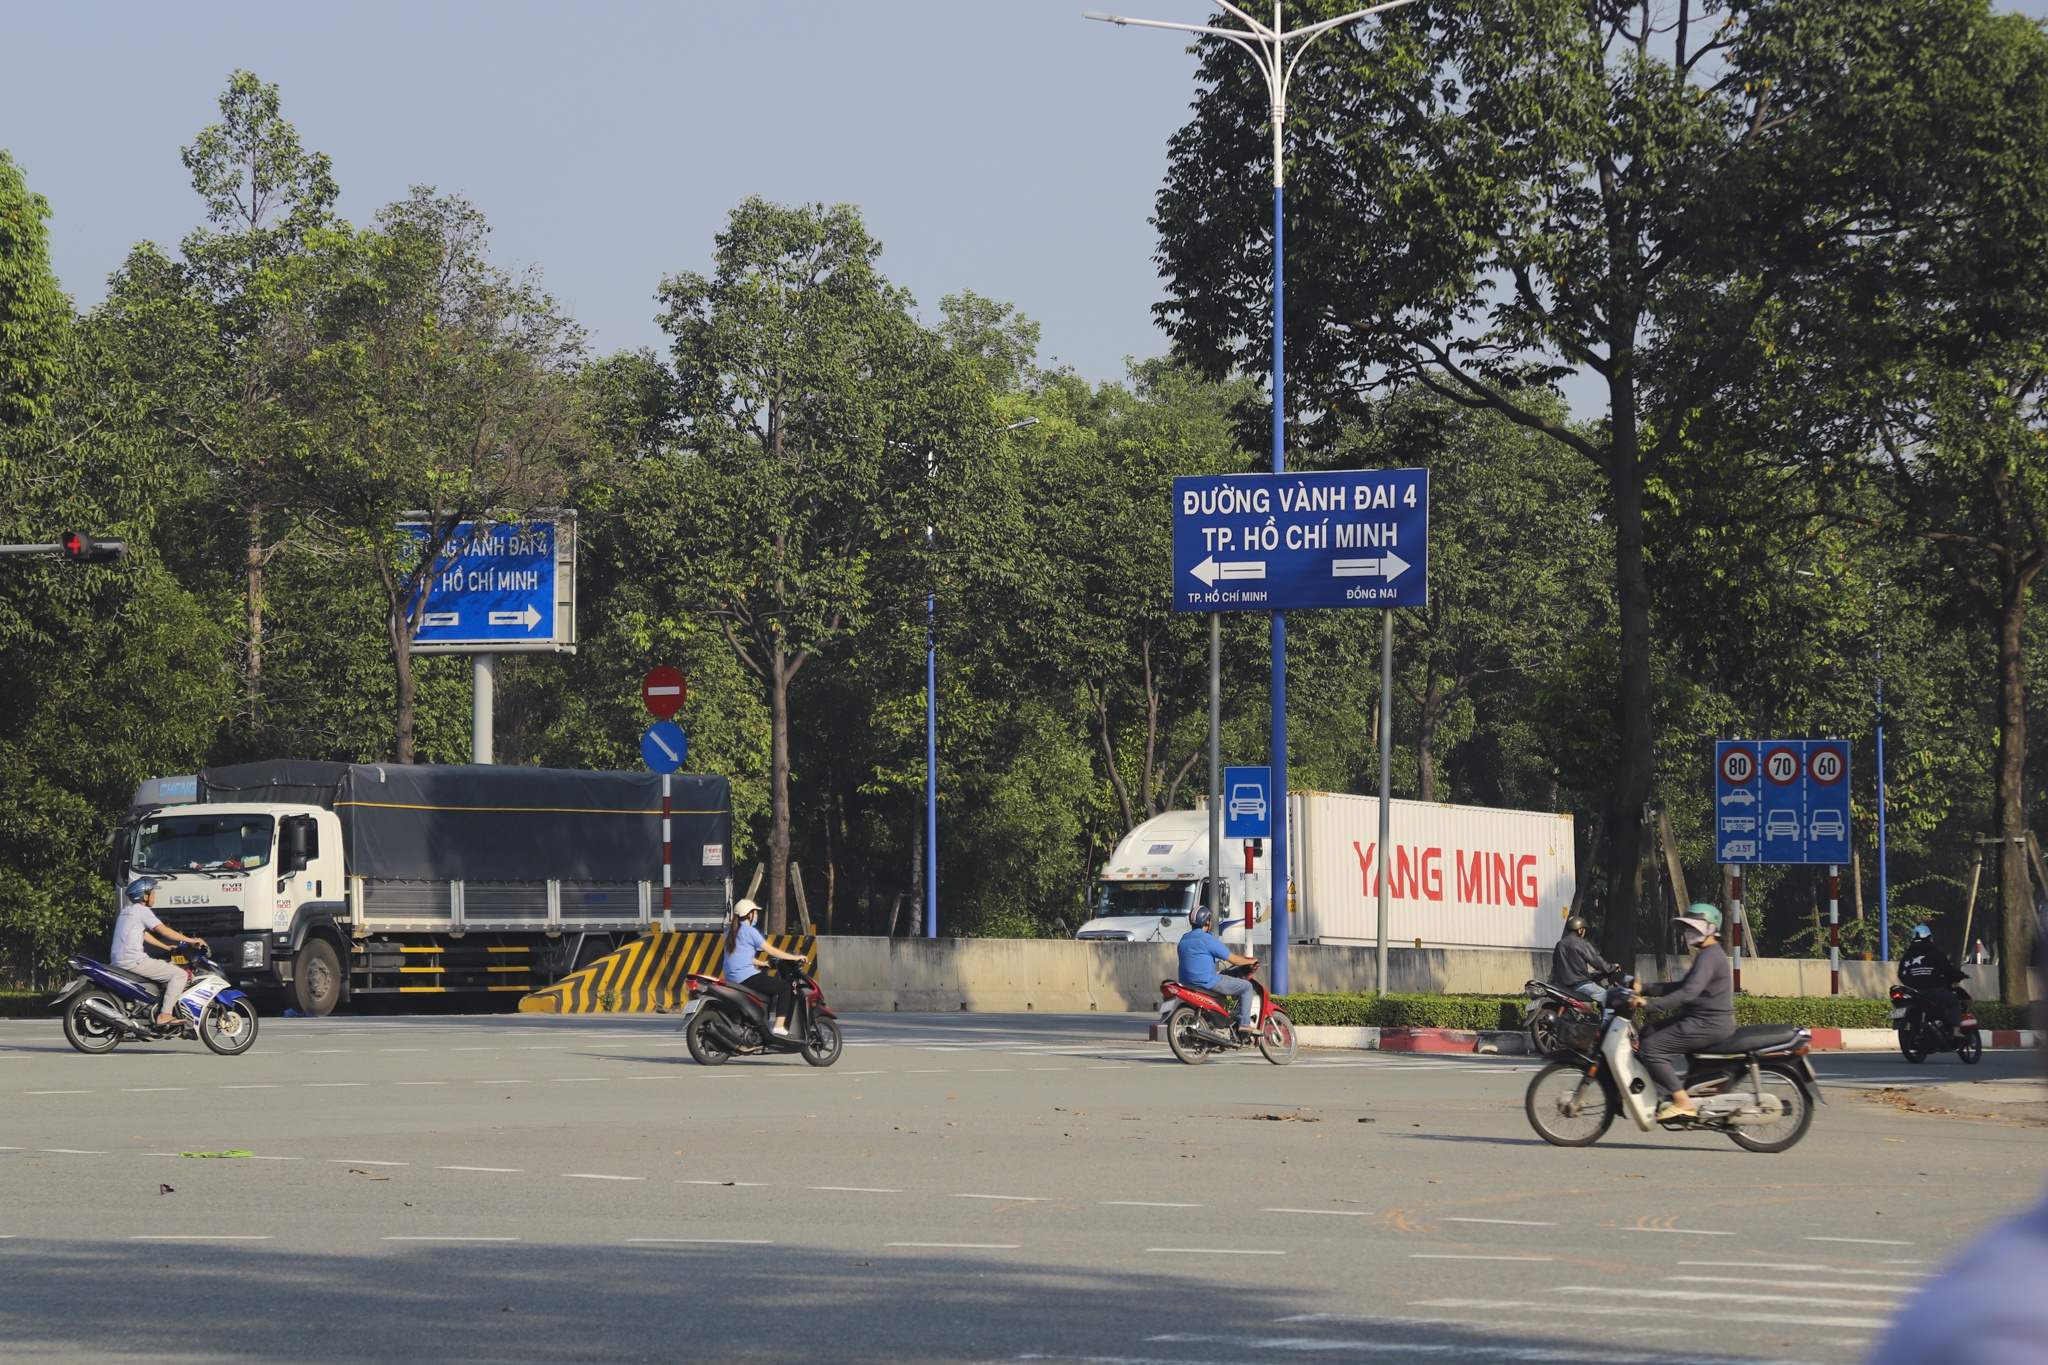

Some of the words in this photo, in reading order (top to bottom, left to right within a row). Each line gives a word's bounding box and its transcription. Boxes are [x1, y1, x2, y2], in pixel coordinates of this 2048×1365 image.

[1183, 483, 1270, 515] ĐƯỜNG
[1278, 481, 1346, 512] VÀNH
[1354, 484, 1396, 510] ĐAI
[1403, 484, 1417, 508] 4
[1201, 527, 1236, 551] TP.
[1244, 515, 1279, 550] HỒ
[1286, 517, 1329, 550] CHÍ
[1335, 522, 1397, 548] MINH
[442, 564, 464, 592] HỒ
[468, 567, 495, 592] CHÍ
[498, 570, 538, 591] MINH
[1188, 593, 1202, 603] TP.
[1222, 589, 1240, 602] CHÍ
[1242, 591, 1268, 602] MINH
[1346, 585, 1377, 600] ĐỒNG
[1379, 588, 1397, 599] NAI
[1729, 757, 1747, 776] 80
[1773, 757, 1791, 776] 70
[1818, 757, 1836, 776] 60
[1353, 841, 1443, 902] YANG
[1456, 849, 1539, 908] MING
[169, 895, 210, 905] ISUZU
